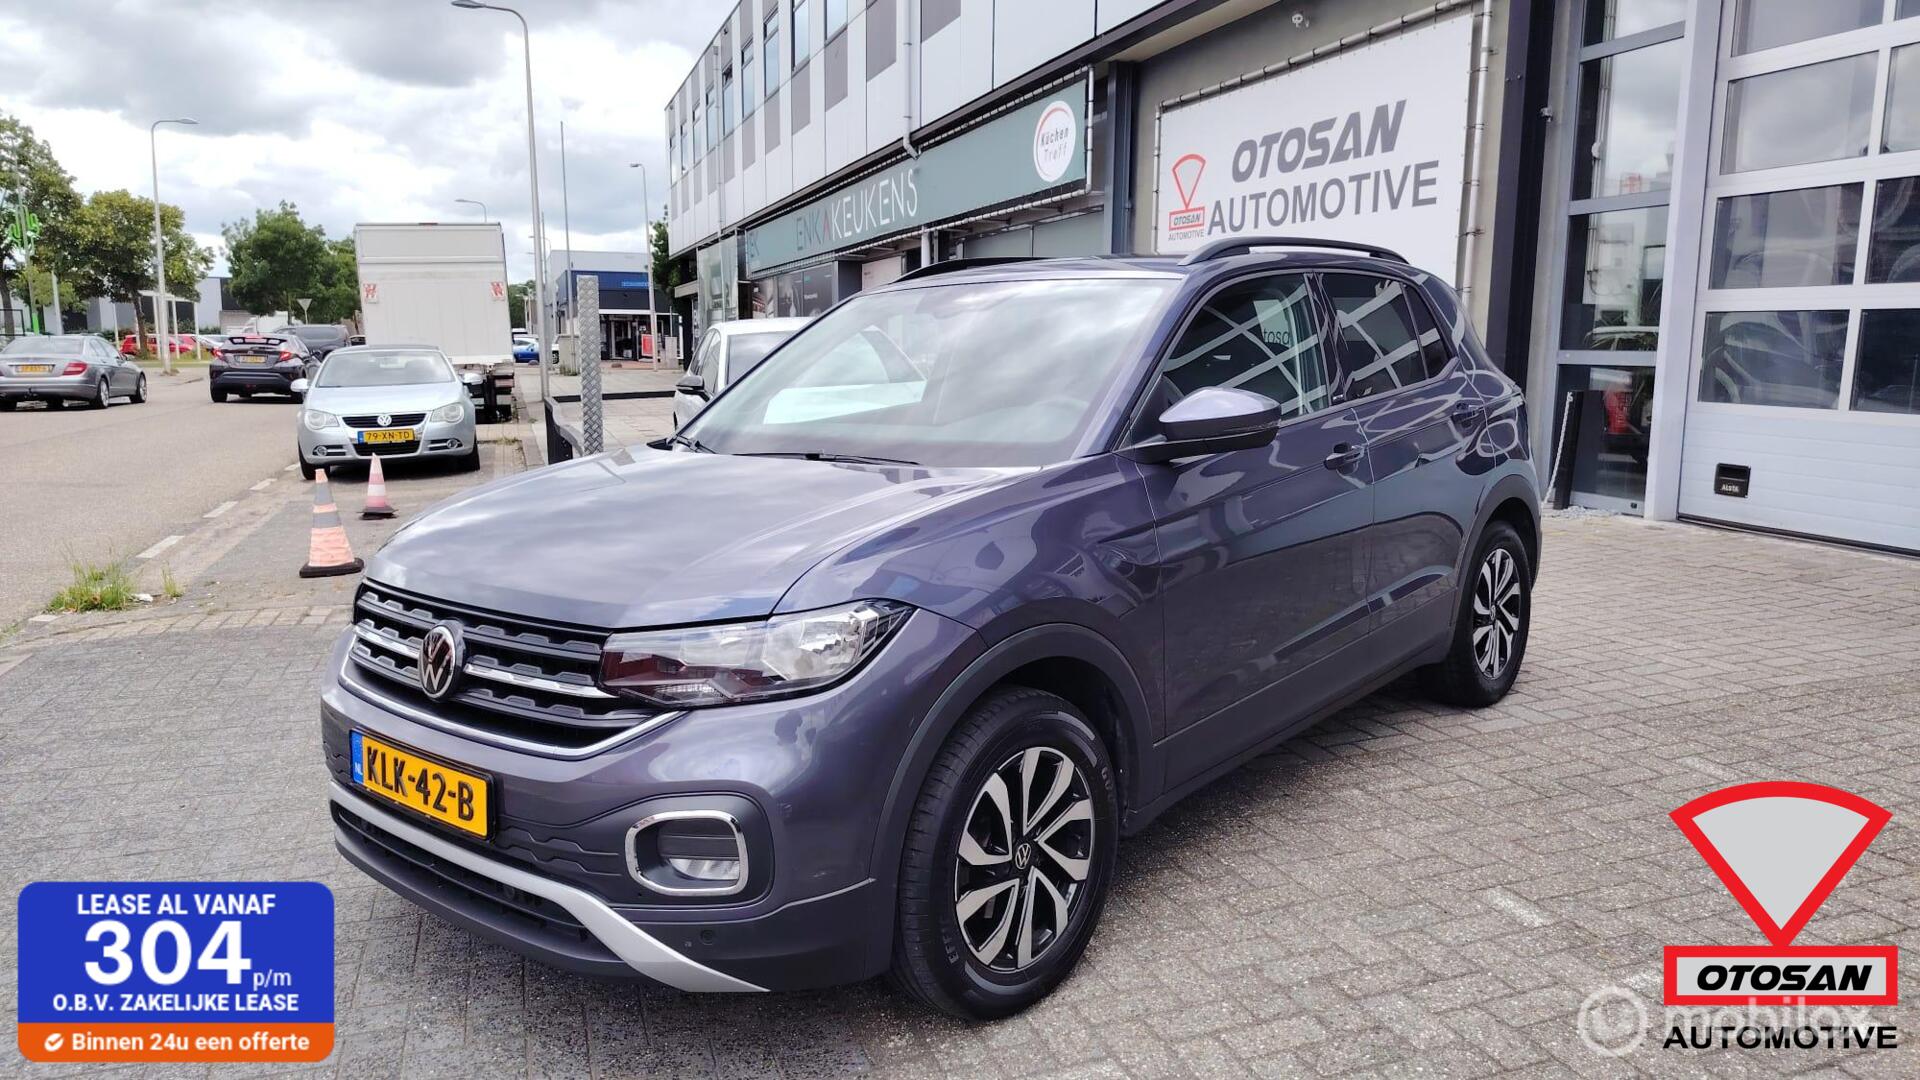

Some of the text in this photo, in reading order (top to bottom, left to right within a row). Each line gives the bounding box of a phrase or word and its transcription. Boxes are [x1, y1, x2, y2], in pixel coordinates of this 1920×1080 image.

[1232, 100, 1407, 183] OTOSAN
[1173, 213, 1201, 227] OTOSAN
[1207, 160, 1439, 236] AUTOMOTIVE
[1168, 229, 1205, 241] AUTOMOTIVE
[354, 762, 363, 775] NL
[367, 746, 474, 821] KLK-42-B
